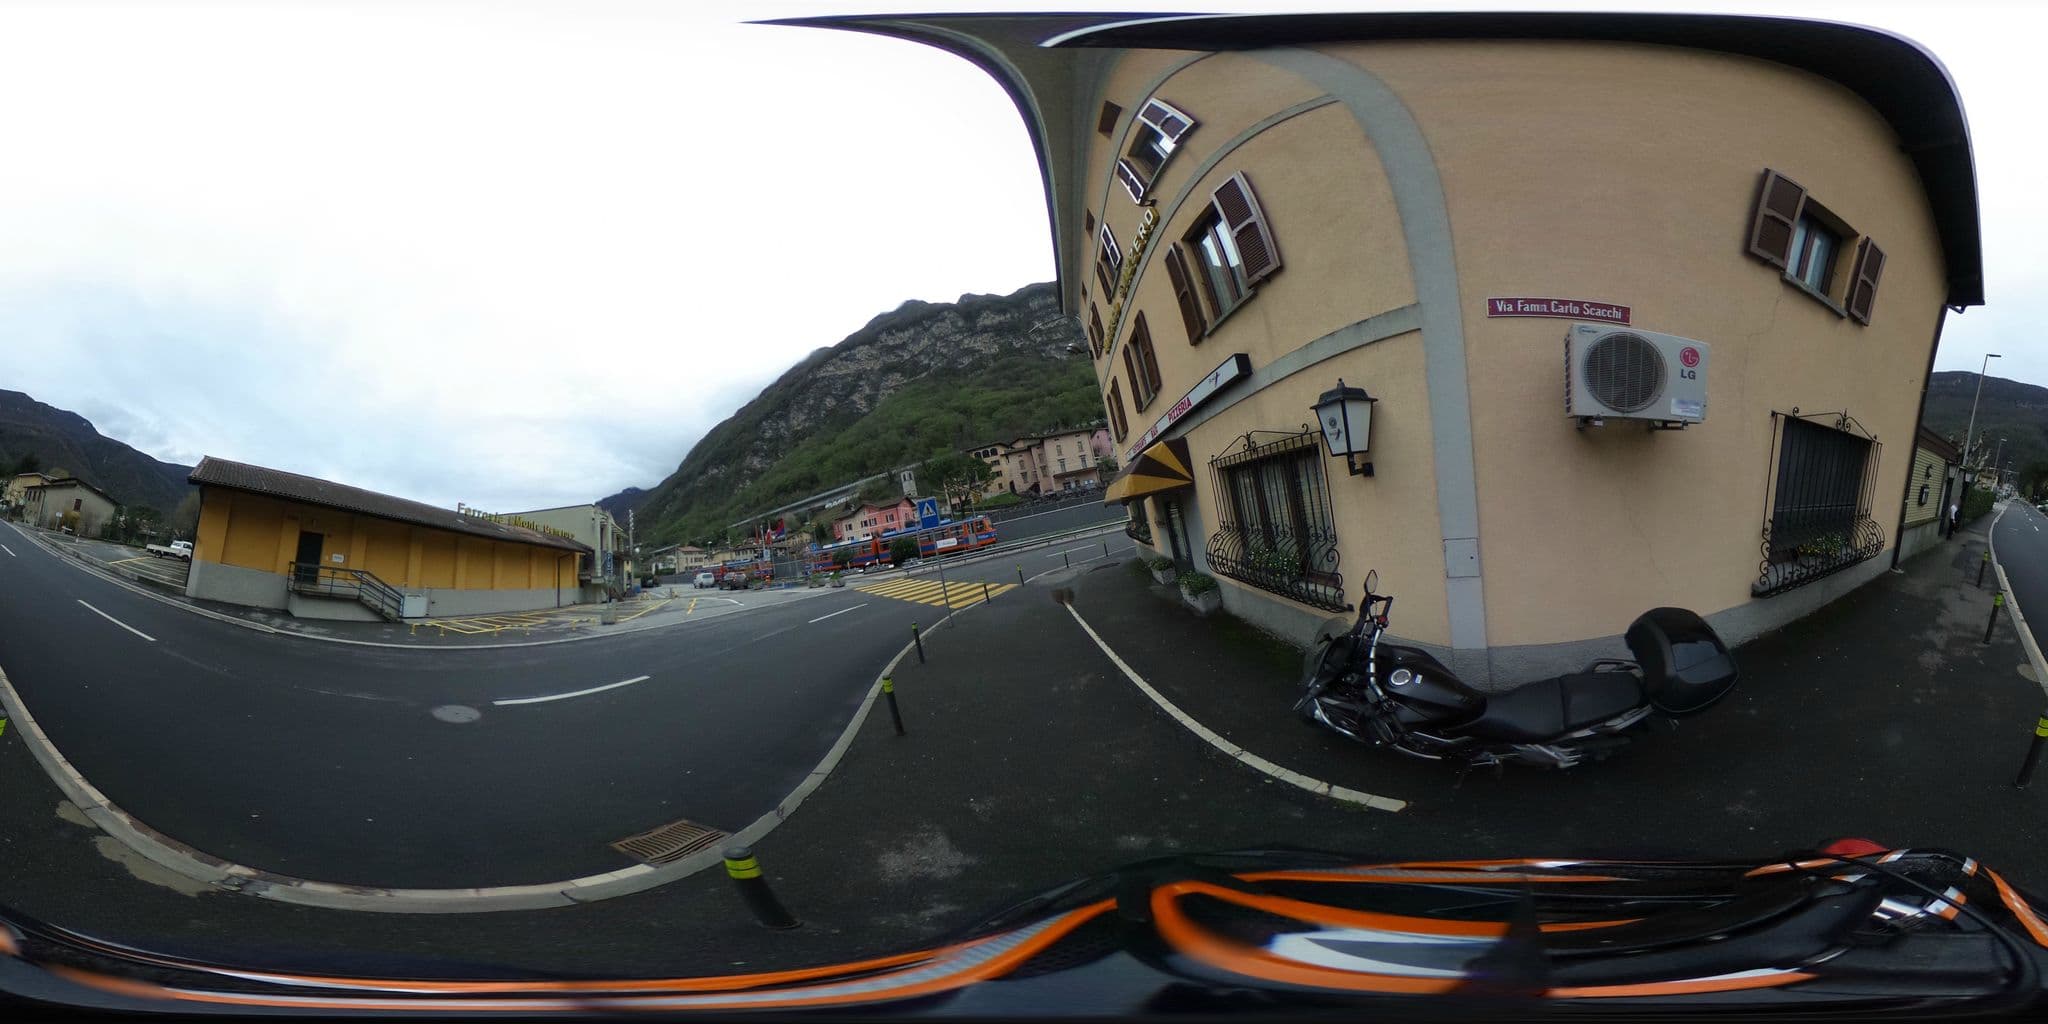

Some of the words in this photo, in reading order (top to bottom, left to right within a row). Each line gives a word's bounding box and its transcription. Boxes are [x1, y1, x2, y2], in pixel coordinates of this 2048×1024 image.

[1496, 300, 1513, 312] Via
[1551, 301, 1579, 314] Carlo
[1583, 303, 1622, 319] Scacchi
[1681, 369, 1696, 380] LG
[1168, 397, 1192, 423] PIZZERIA
